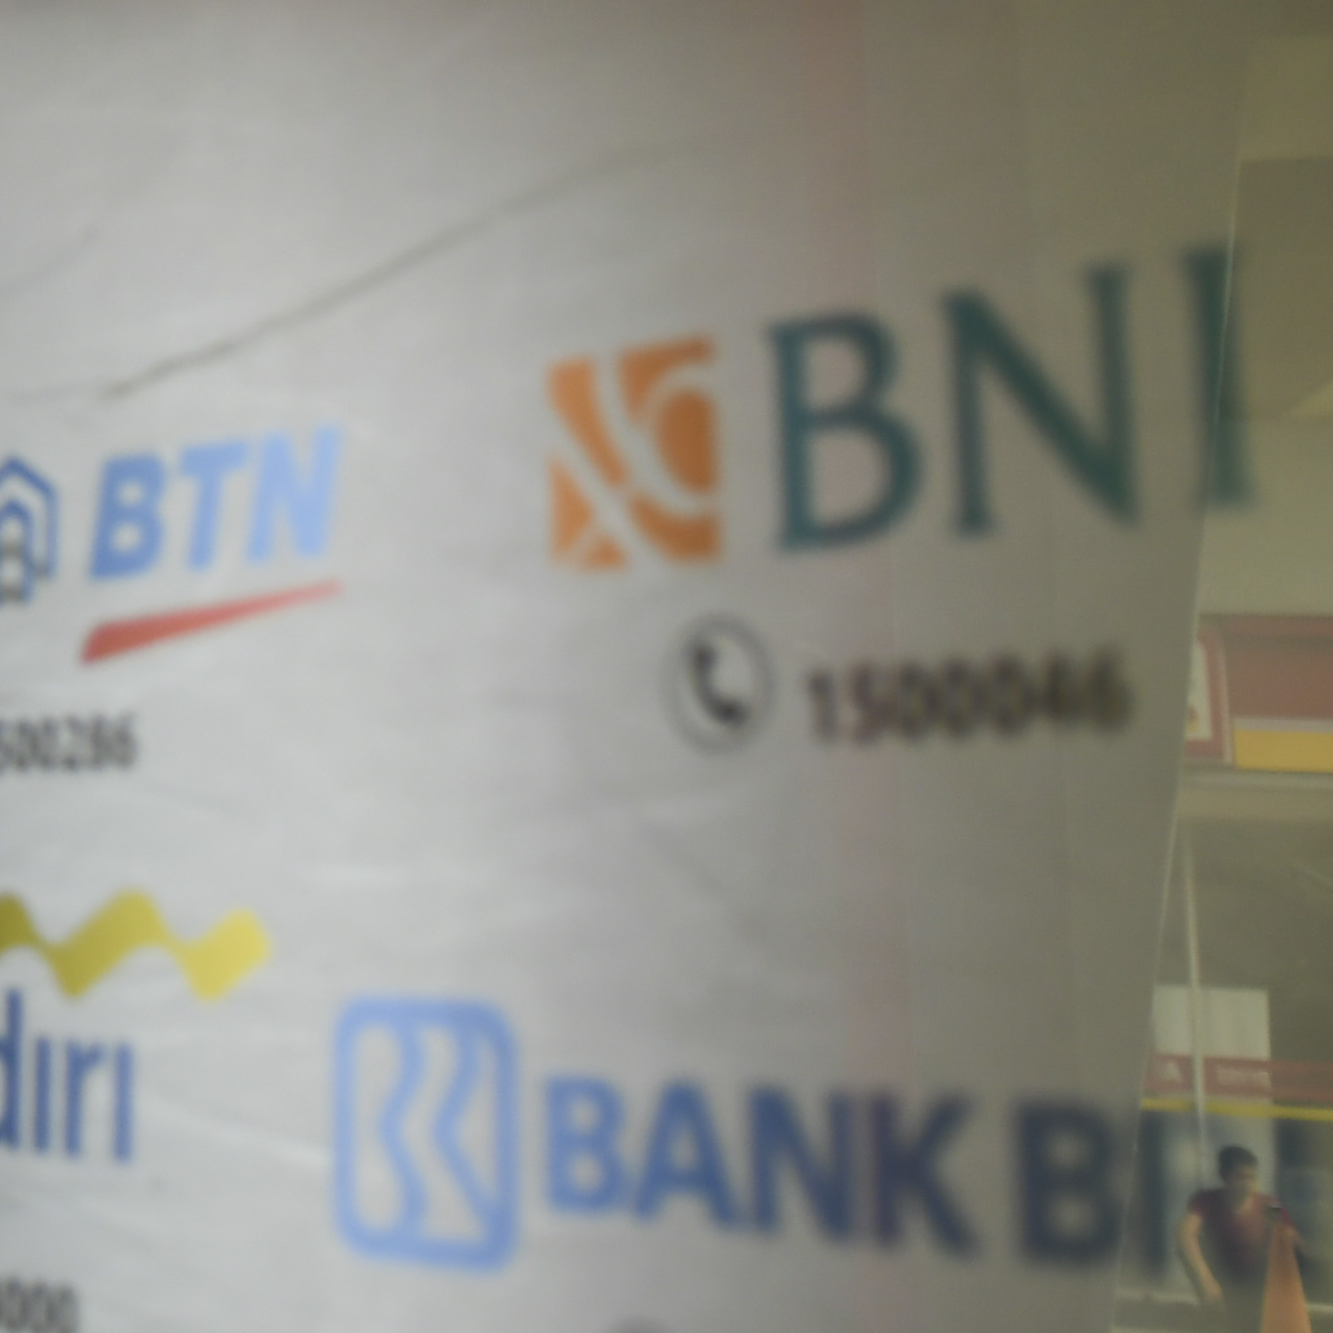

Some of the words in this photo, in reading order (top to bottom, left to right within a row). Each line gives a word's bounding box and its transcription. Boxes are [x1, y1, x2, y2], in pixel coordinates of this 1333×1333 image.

[767, 240, 1257, 554] BNI
[88, 423, 344, 582] BTN
[543, 1074, 977, 1262] BANK
